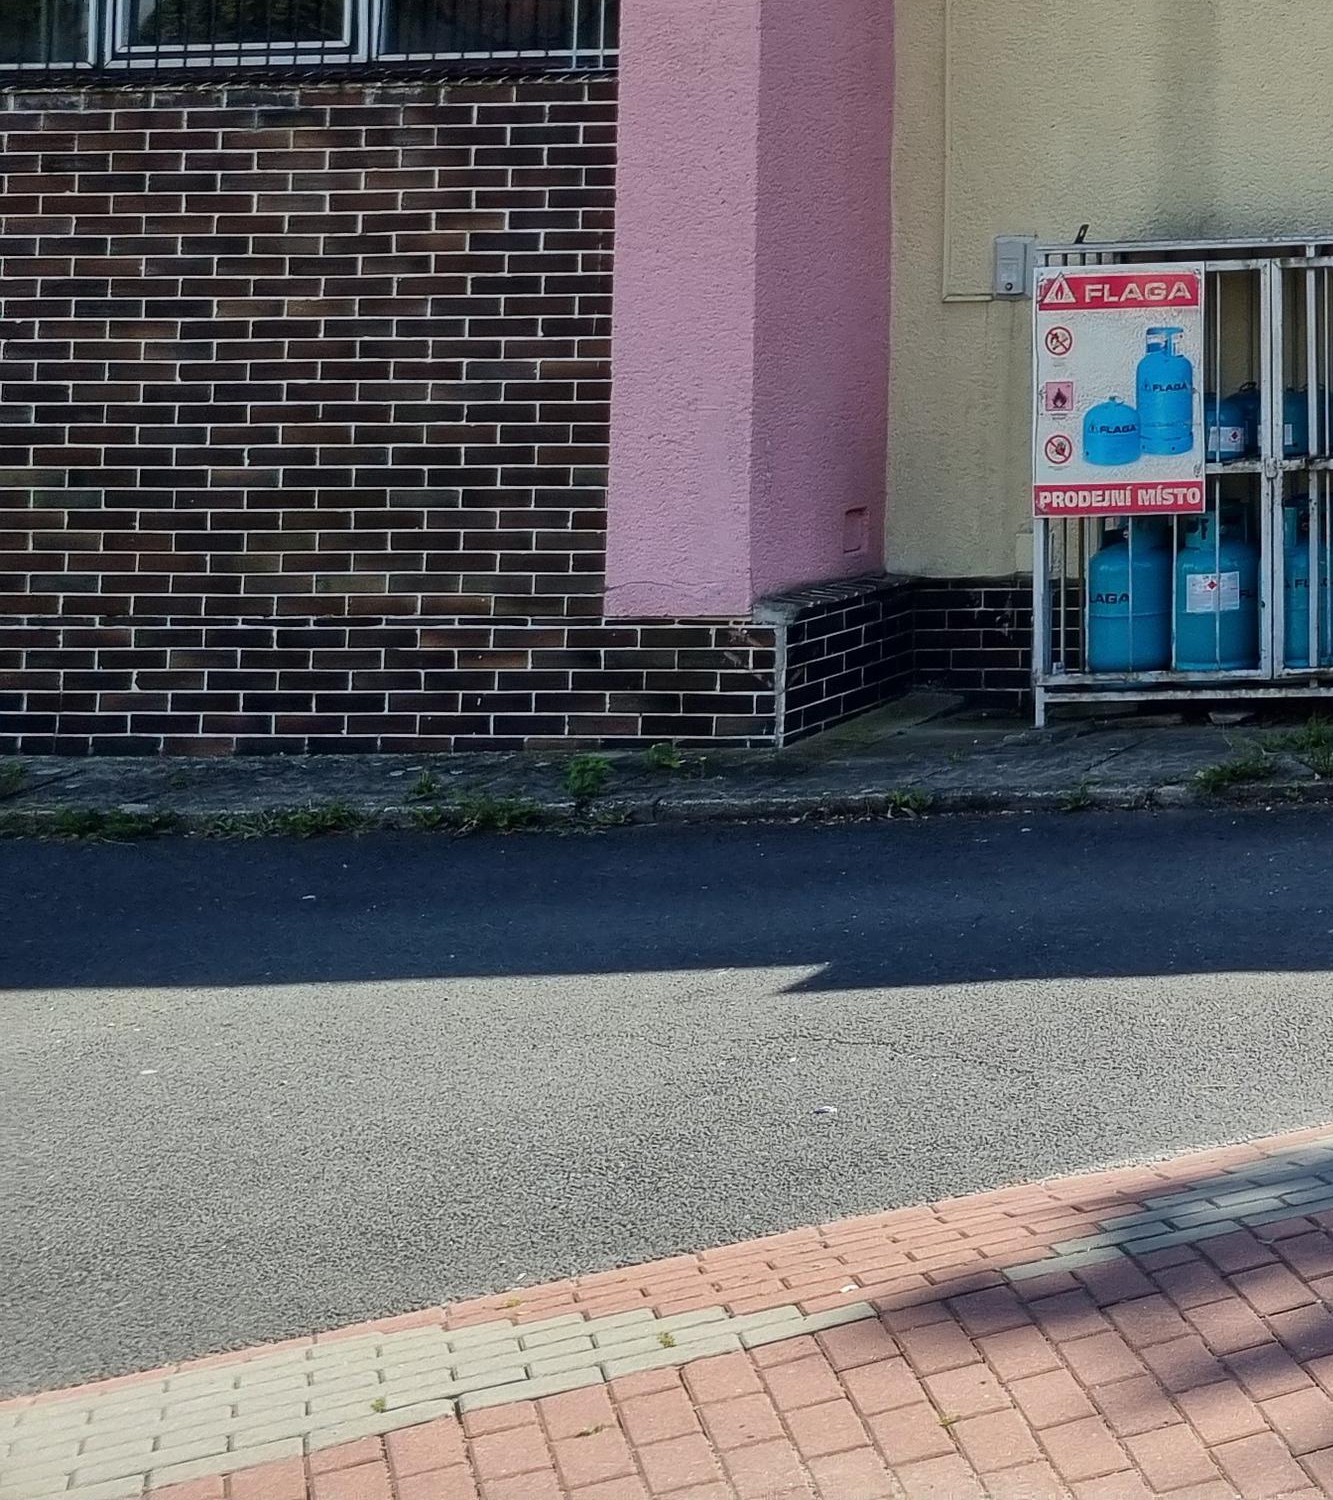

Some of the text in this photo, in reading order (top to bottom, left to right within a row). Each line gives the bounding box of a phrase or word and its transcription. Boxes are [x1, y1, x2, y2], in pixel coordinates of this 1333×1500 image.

[1085, 281, 1192, 303] FLAGA
[1152, 383, 1188, 392] FLAGA
[1099, 424, 1137, 434] FLAGA
[1039, 485, 1200, 508] PRODEJNÍ MÍSTO
[1087, 593, 1131, 605] LAGA
